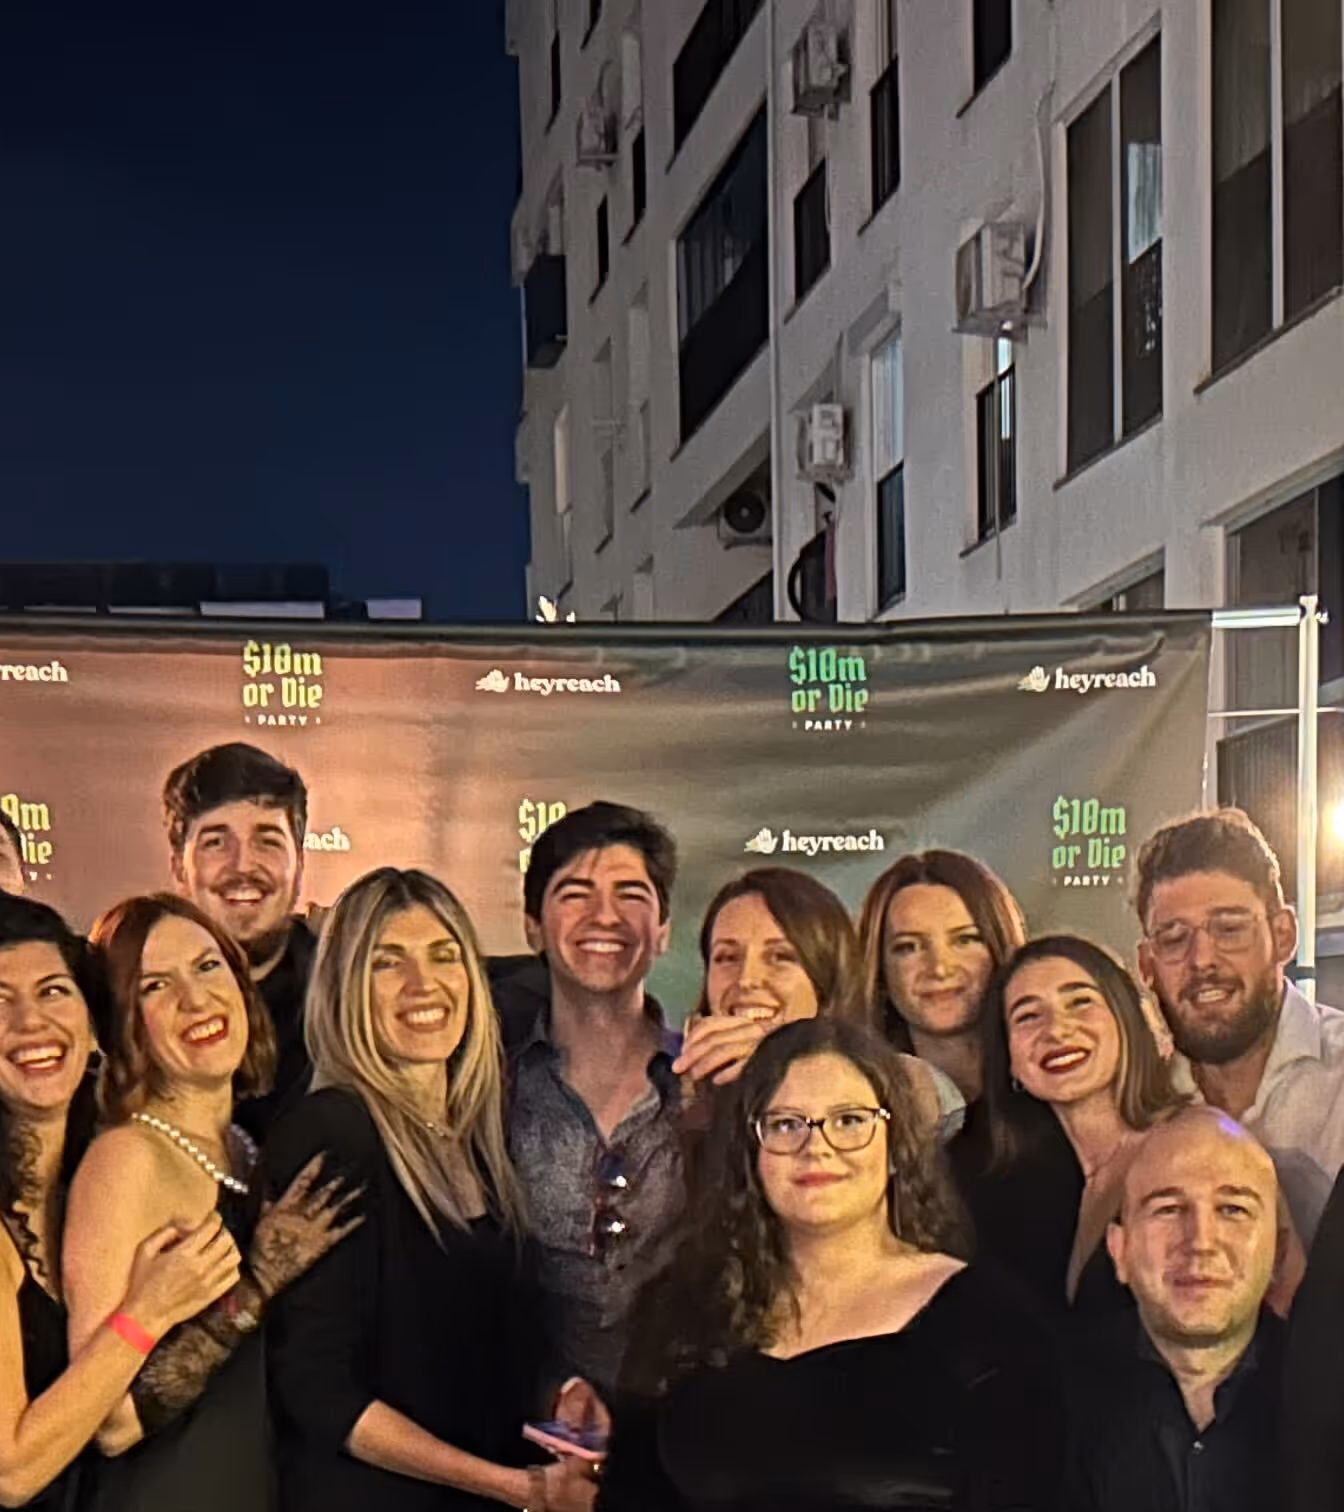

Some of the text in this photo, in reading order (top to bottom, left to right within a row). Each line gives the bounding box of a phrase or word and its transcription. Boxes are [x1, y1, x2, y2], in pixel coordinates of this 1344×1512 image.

[242, 639, 323, 677] $10m
[789, 645, 867, 685] $10m
[243, 676, 323, 708] or Die
[513, 672, 621, 696] heyreach
[1054, 665, 1156, 694] heyreach
[791, 682, 869, 713] or Die
[258, 715, 307, 725] PARTY
[804, 719, 853, 731] PARTY
[518, 798, 567, 843] $10
[1053, 795, 1126, 840] $10m
[782, 829, 885, 857] heyreach
[1052, 837, 1126, 869] or Die
[1063, 875, 1110, 887] PARTY
